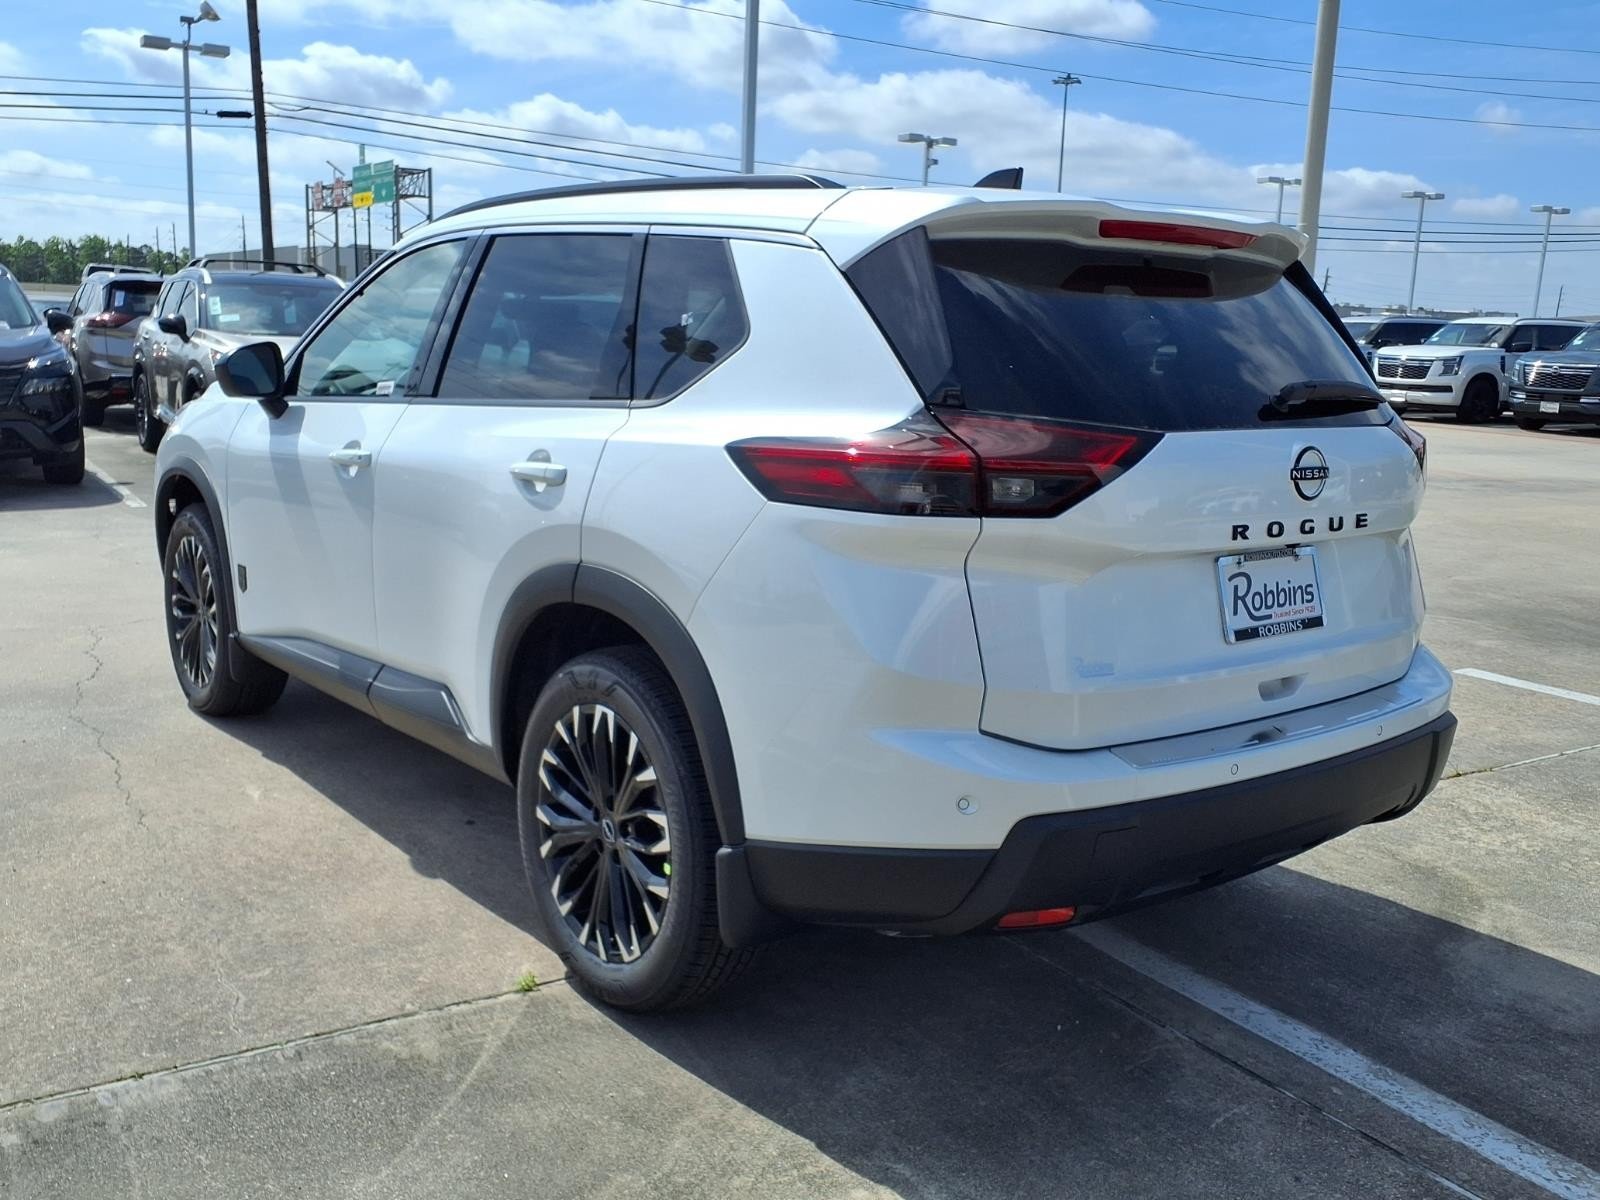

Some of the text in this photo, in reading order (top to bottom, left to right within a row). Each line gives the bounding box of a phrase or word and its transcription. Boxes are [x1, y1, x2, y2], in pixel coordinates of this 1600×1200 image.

[1292, 468, 1329, 479] NISSAN
[1232, 513, 1368, 541] ROGUE
[1228, 571, 1315, 622] Robbins
[1258, 620, 1303, 637] ROBBINS
